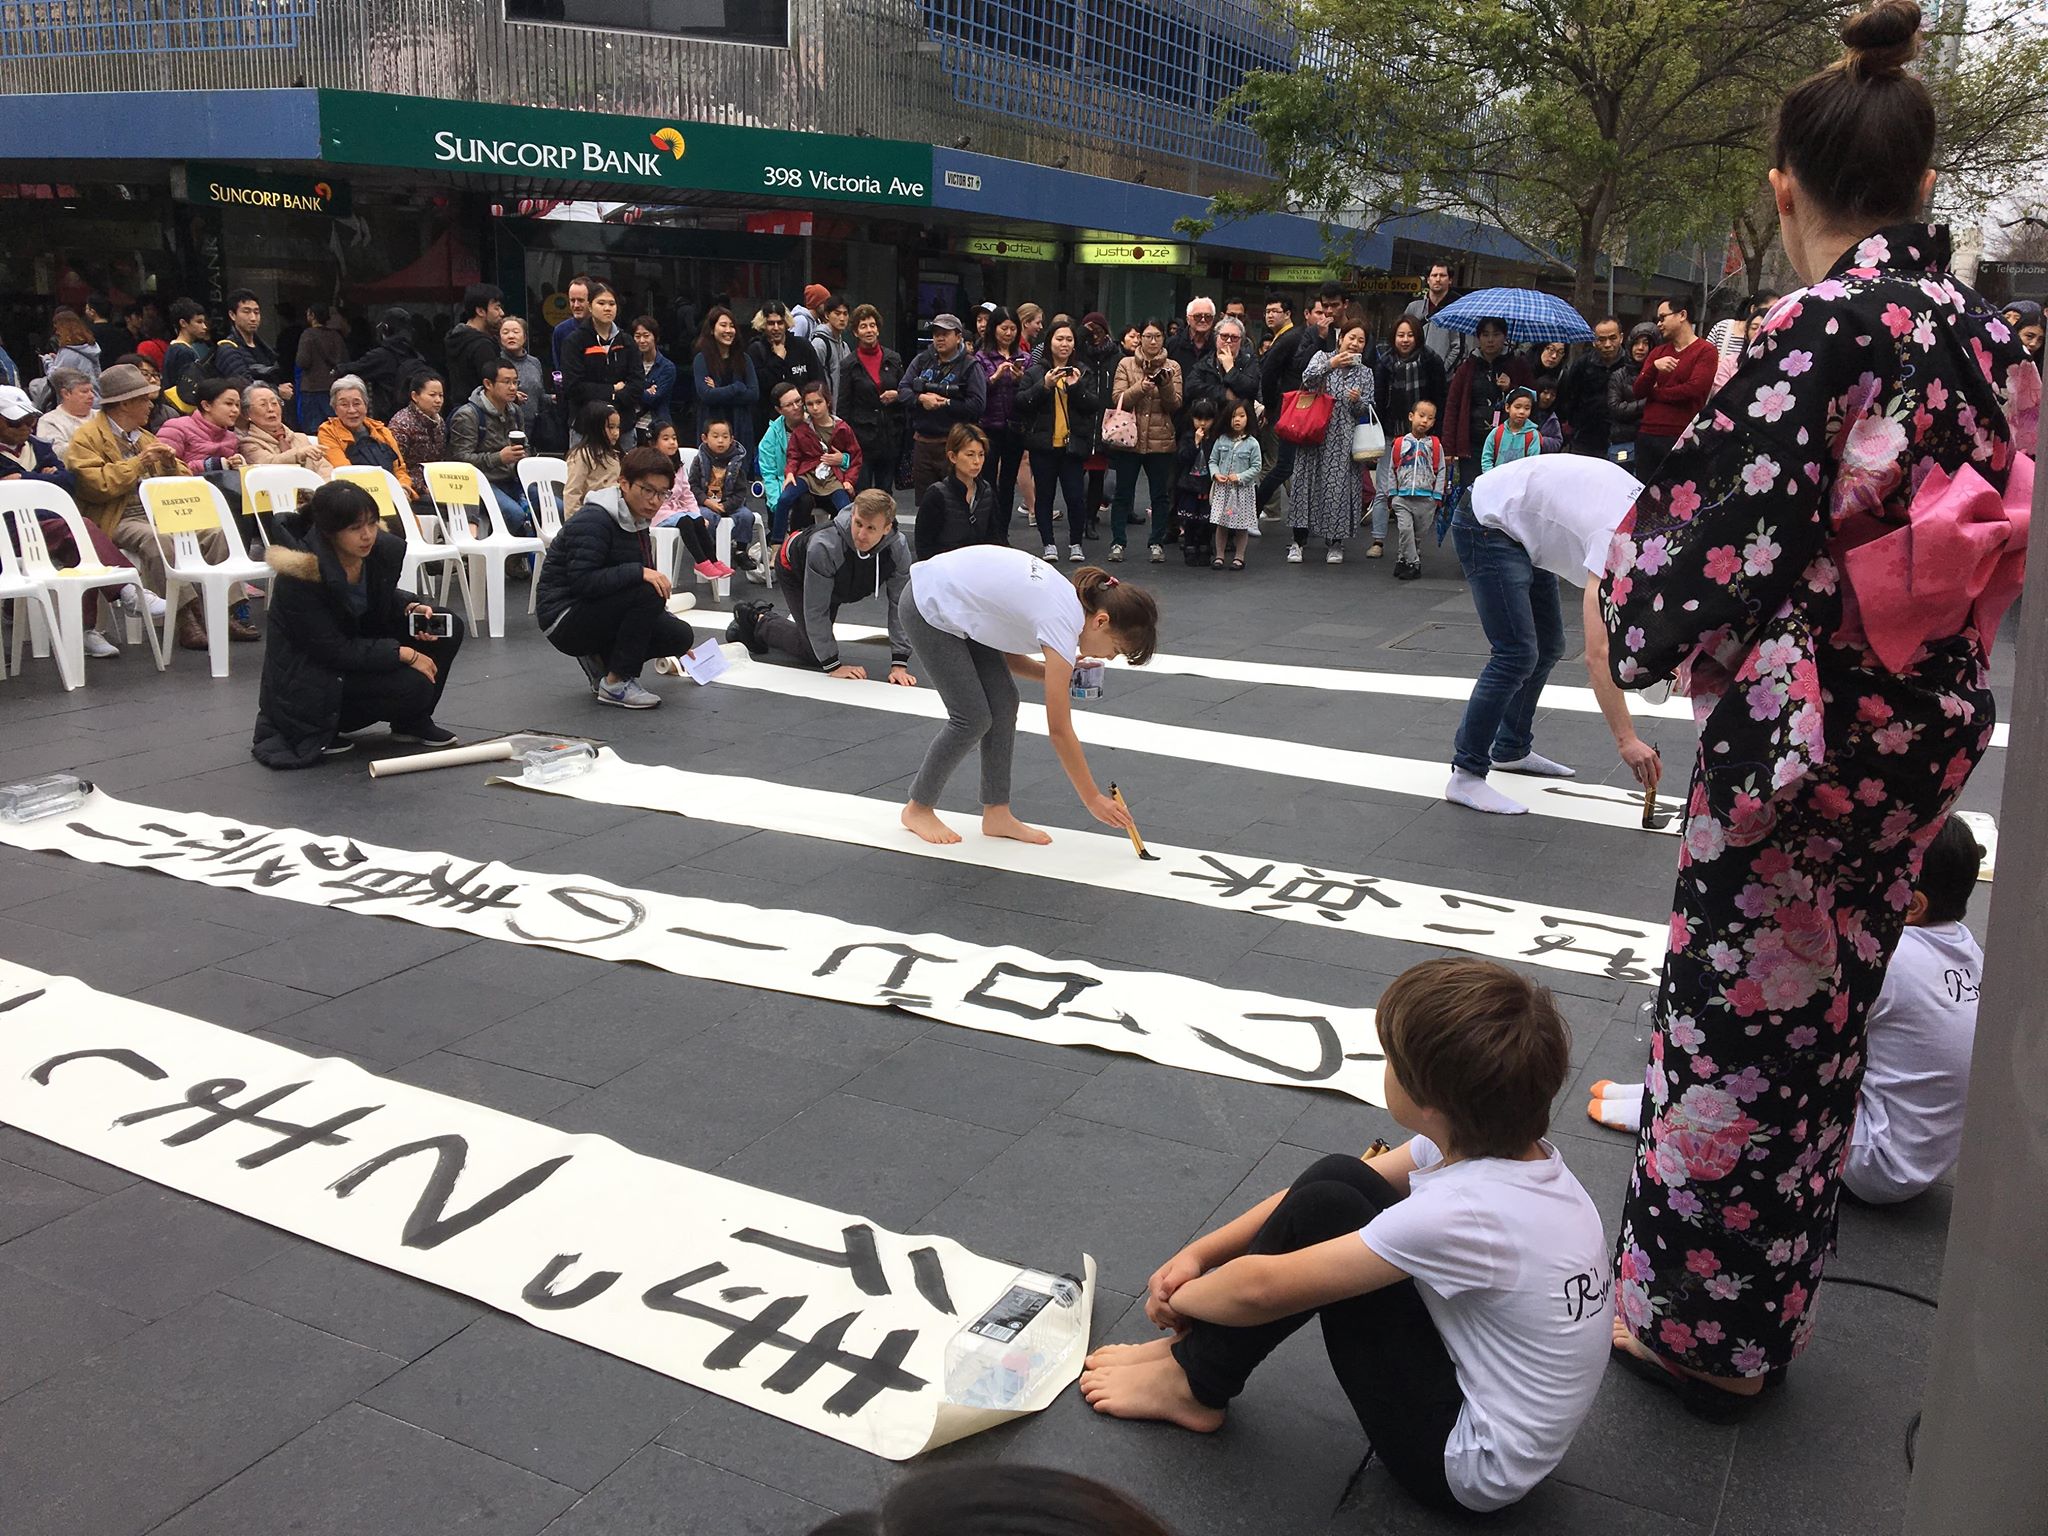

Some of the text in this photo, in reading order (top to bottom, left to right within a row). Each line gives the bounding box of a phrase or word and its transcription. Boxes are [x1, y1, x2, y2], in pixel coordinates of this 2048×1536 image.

[434, 131, 662, 176] SUNCORP BANK
[763, 166, 924, 197] 398 Victoria Ave
[947, 171, 974, 188] VICTOR ST
[209, 183, 323, 212] SUNCORP BANK
[1995, 263, 2047, 275] Telephone
[1391, 280, 1418, 290] Store
[439, 473, 470, 481] RESERVED
[161, 496, 201, 506] RESERVED
[1170, 855, 1663, 981] ぱい楽
[0, 986, 957, 1418] 待ってまし
